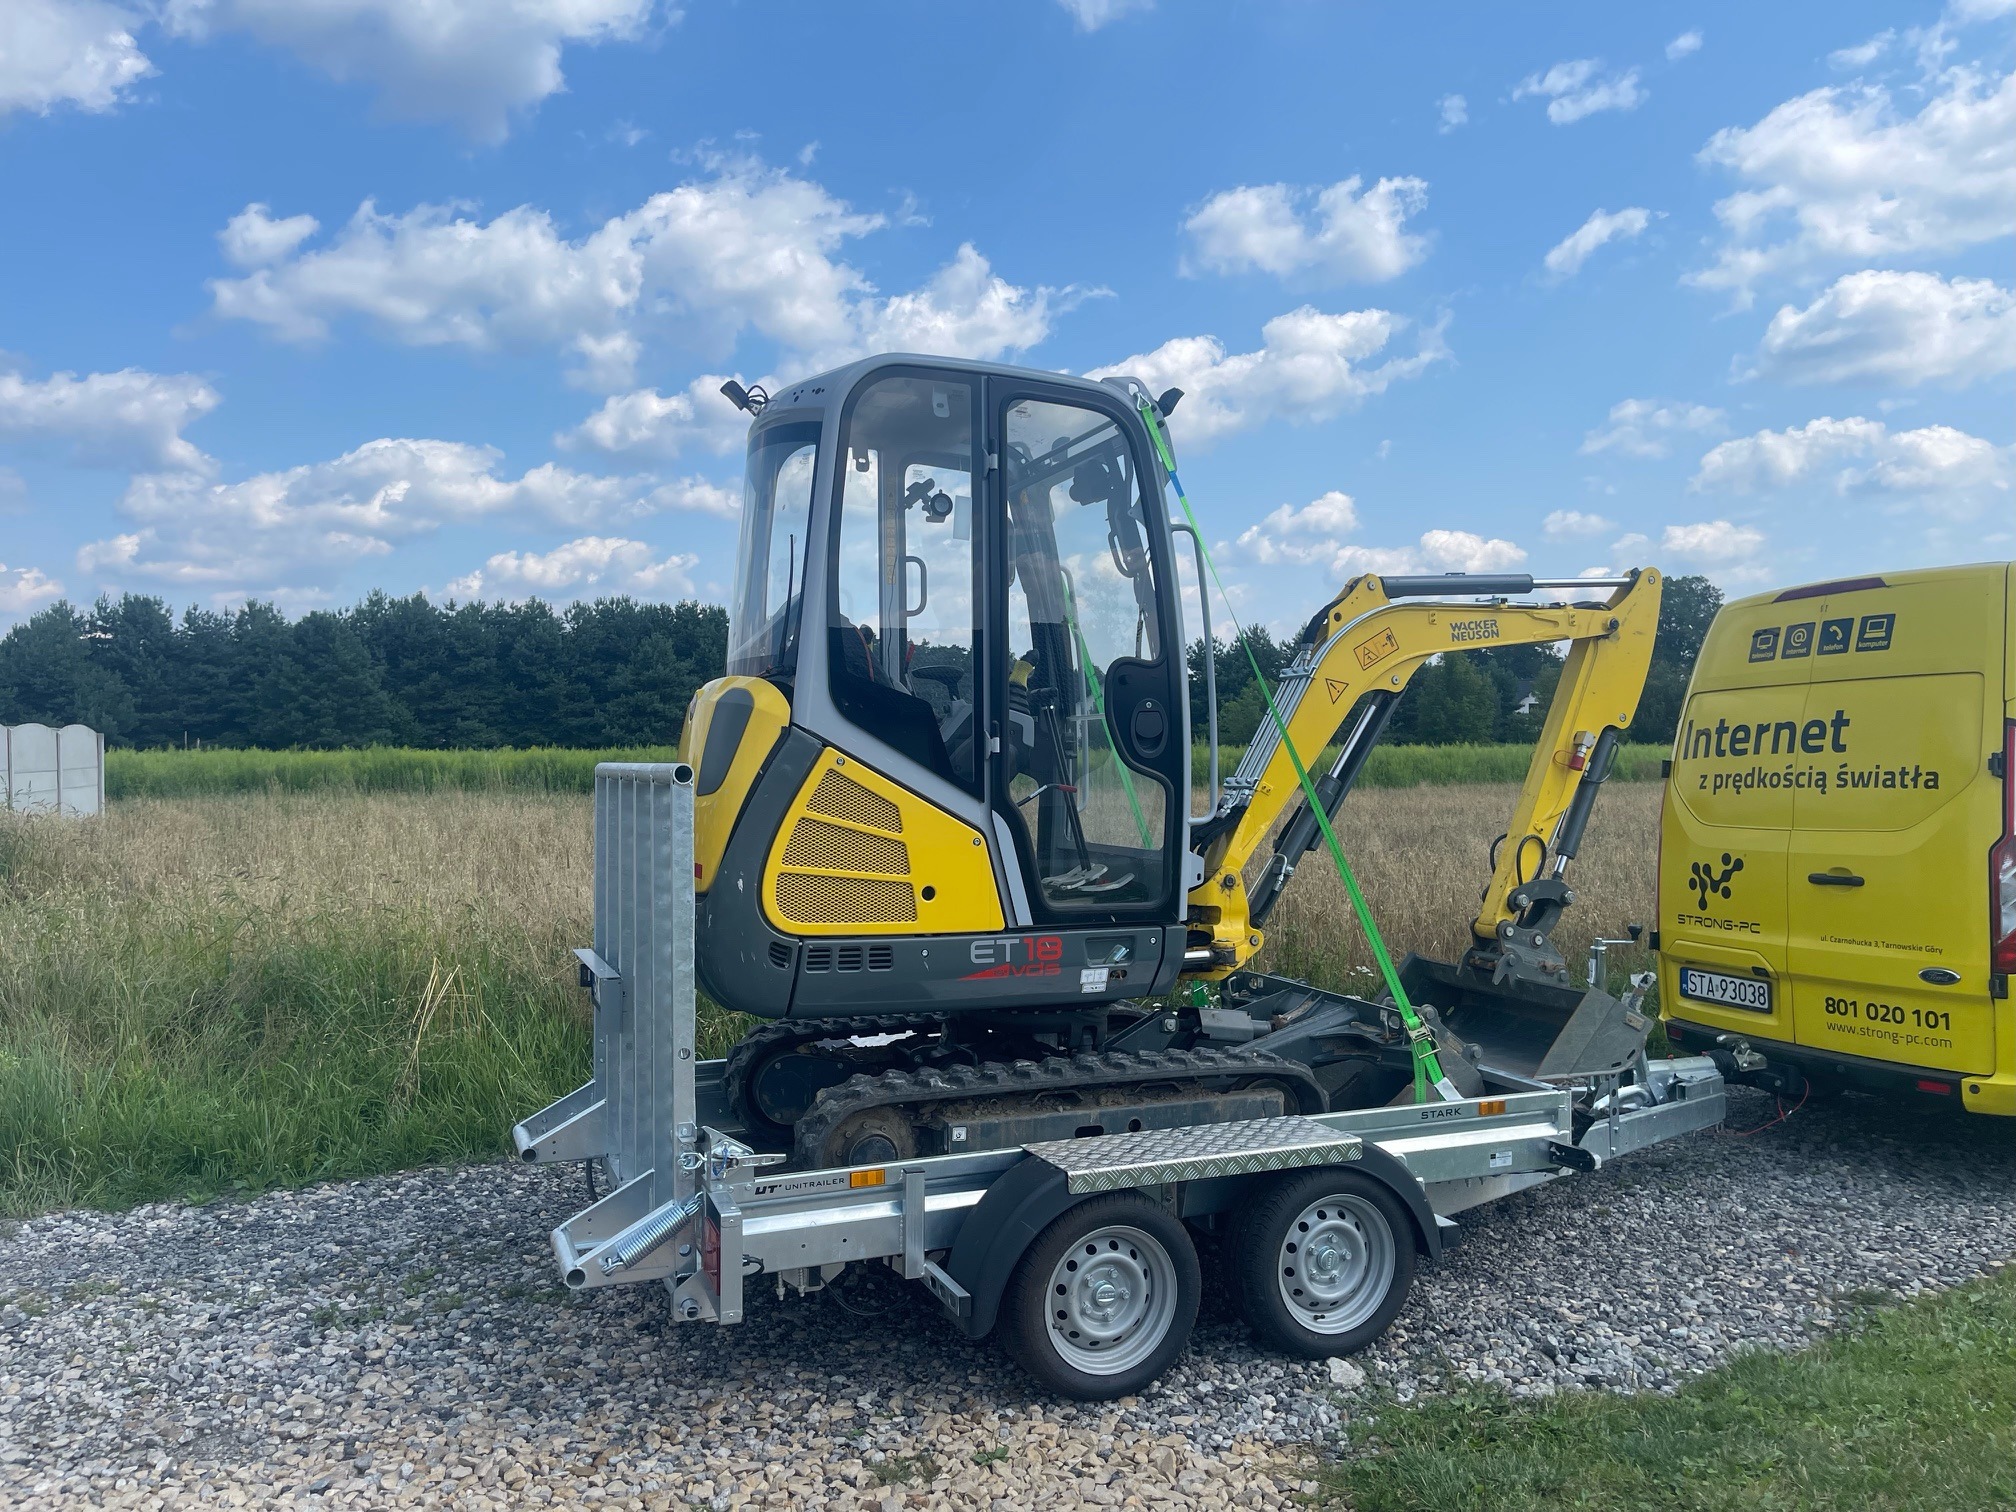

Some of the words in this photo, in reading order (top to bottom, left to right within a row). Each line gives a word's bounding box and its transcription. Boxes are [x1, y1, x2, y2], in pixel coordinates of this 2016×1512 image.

[1450, 619, 1498, 631] WACKER
[1451, 629, 1499, 642] NEUSON
[1858, 640, 1888, 649] komputer
[1683, 709, 1850, 760] Internet
[1699, 774, 1708, 790] z
[1713, 764, 1828, 795] prędkością
[1836, 763, 1940, 790] światła
[1678, 914, 1760, 934] STRONG-PC
[1830, 935, 1872, 947] Czarnohucka
[1881, 941, 1923, 952] Tarnowskie
[1925, 945, 1943, 955] Góry
[1689, 973, 1715, 997] STA
[1720, 978, 1767, 1006] 93038
[1825, 997, 1857, 1018] 801
[1866, 1003, 1905, 1024] 020
[1912, 1009, 1950, 1030] 101
[1827, 1022, 1952, 1048] www.strong-pc.com
[1421, 1107, 1462, 1119] STARK
[785, 1177, 845, 1191] UNITRAILER
